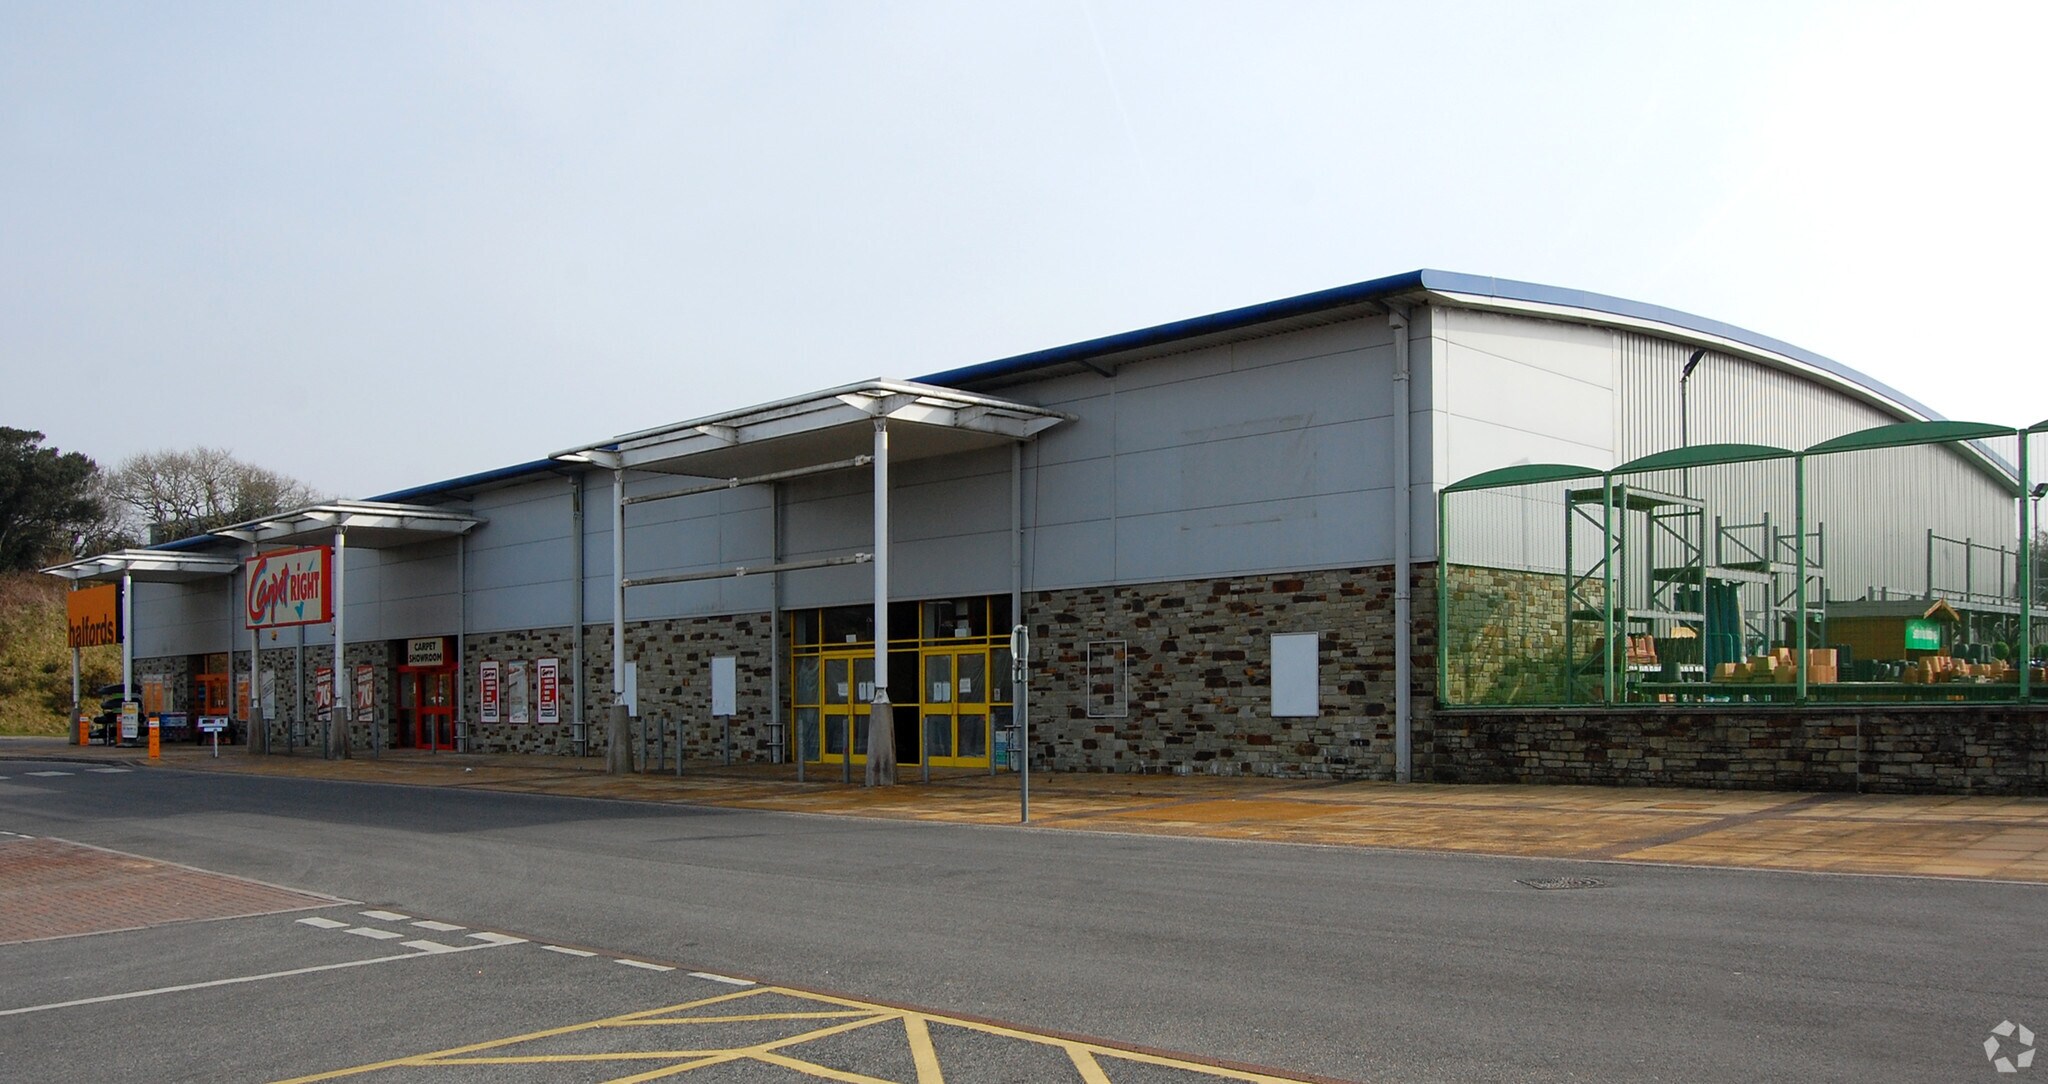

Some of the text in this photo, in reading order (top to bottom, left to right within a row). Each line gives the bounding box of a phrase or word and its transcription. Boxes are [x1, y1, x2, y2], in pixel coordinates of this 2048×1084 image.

[249, 556, 289, 625] Carpet
[68, 613, 115, 648] halfords
[409, 653, 442, 662] SHOWROOM
[414, 642, 436, 651] CARPET
